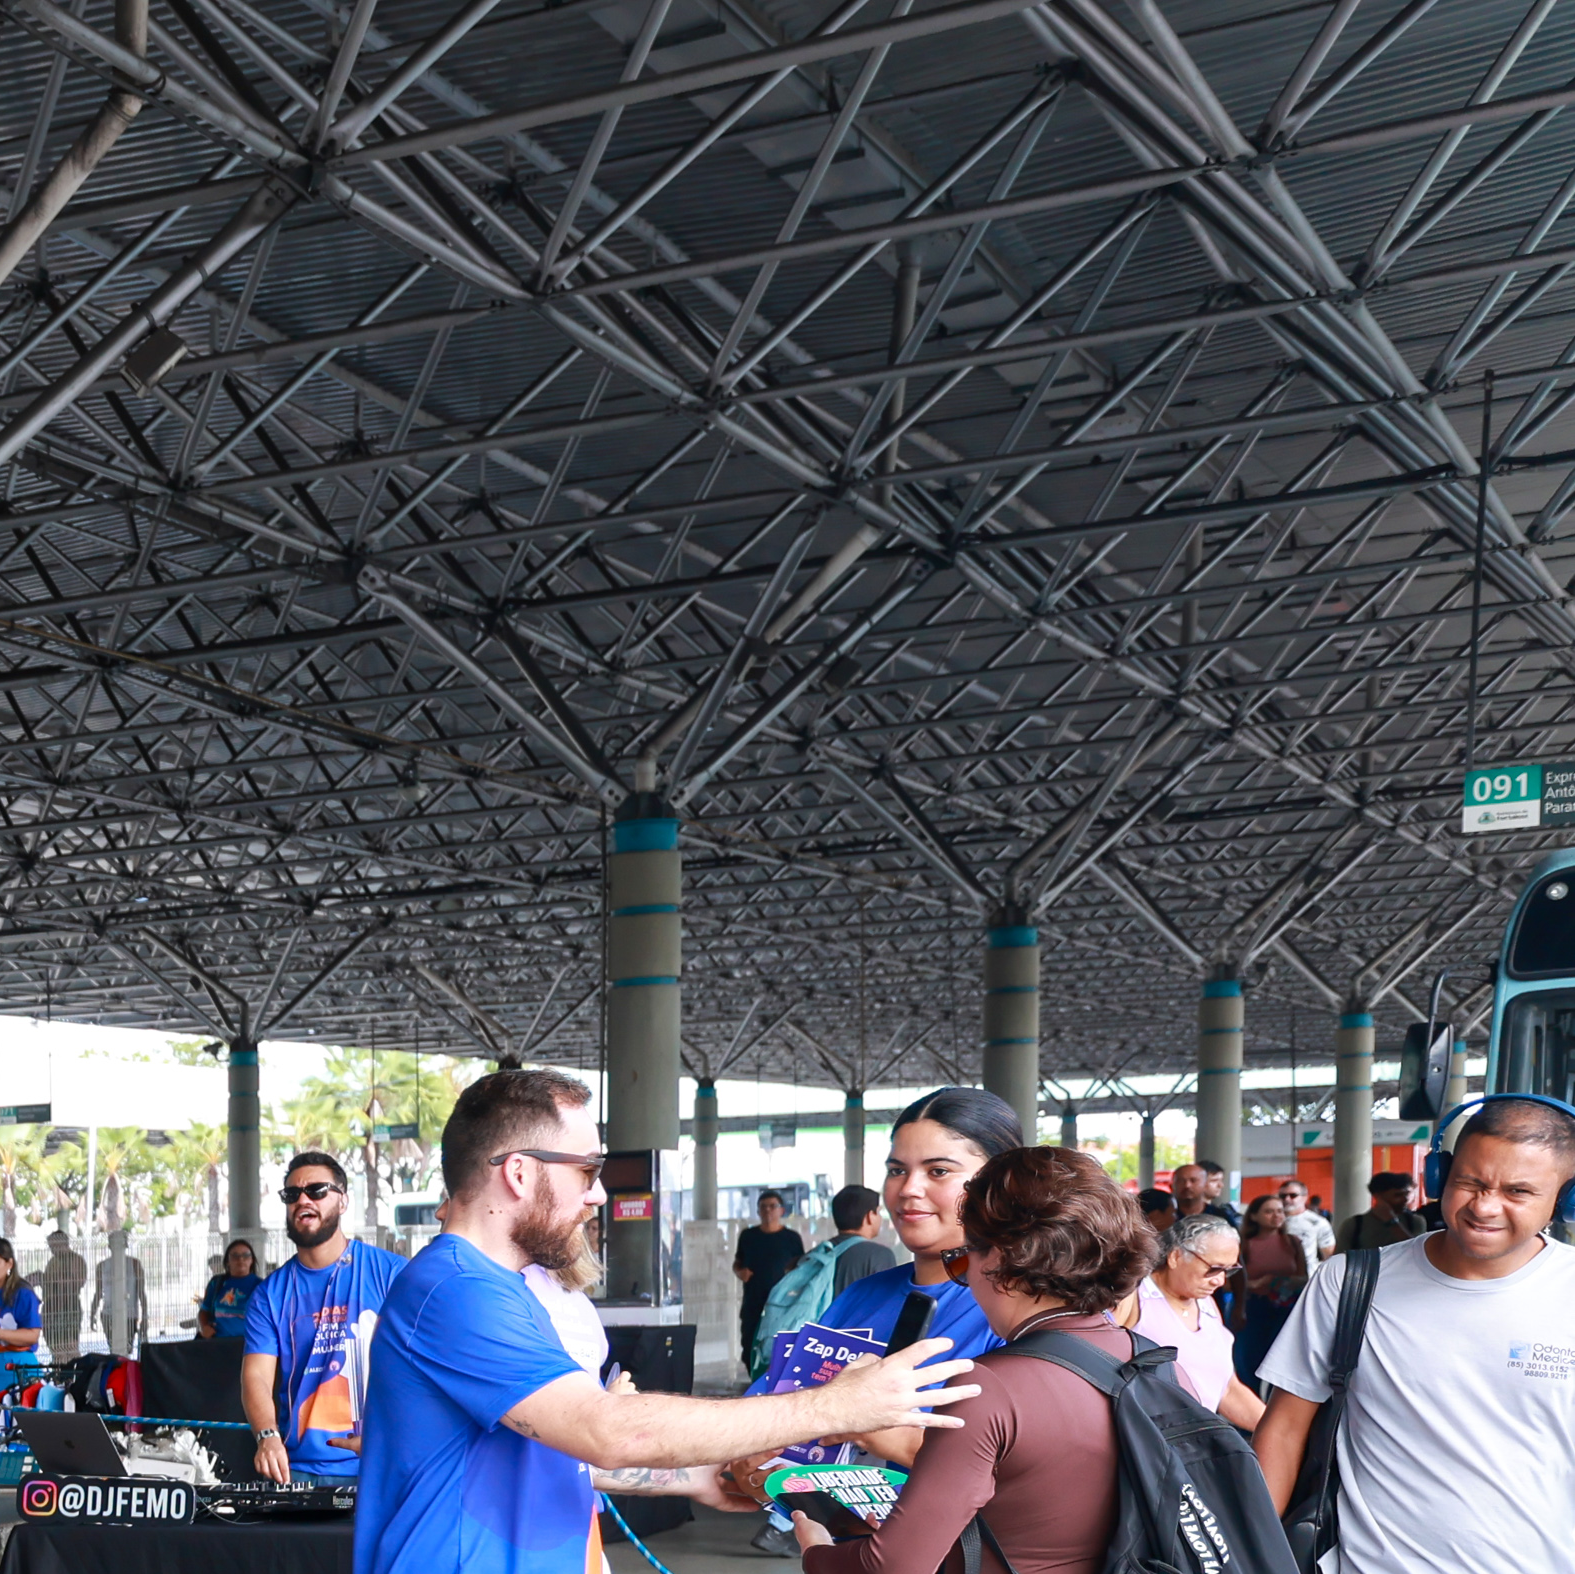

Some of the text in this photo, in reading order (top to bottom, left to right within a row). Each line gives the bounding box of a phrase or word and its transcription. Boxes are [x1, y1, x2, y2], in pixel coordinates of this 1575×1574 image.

[1473, 772, 1528, 802] 091
[804, 1337, 834, 1359] Zap
[835, 1347, 863, 1363] Del
[1507, 1361, 1524, 1369] (85)
[808, 1469, 889, 1489] LIBERDADE
[58, 1484, 186, 1520] @DJFEMO
[866, 1485, 899, 1502] TER
